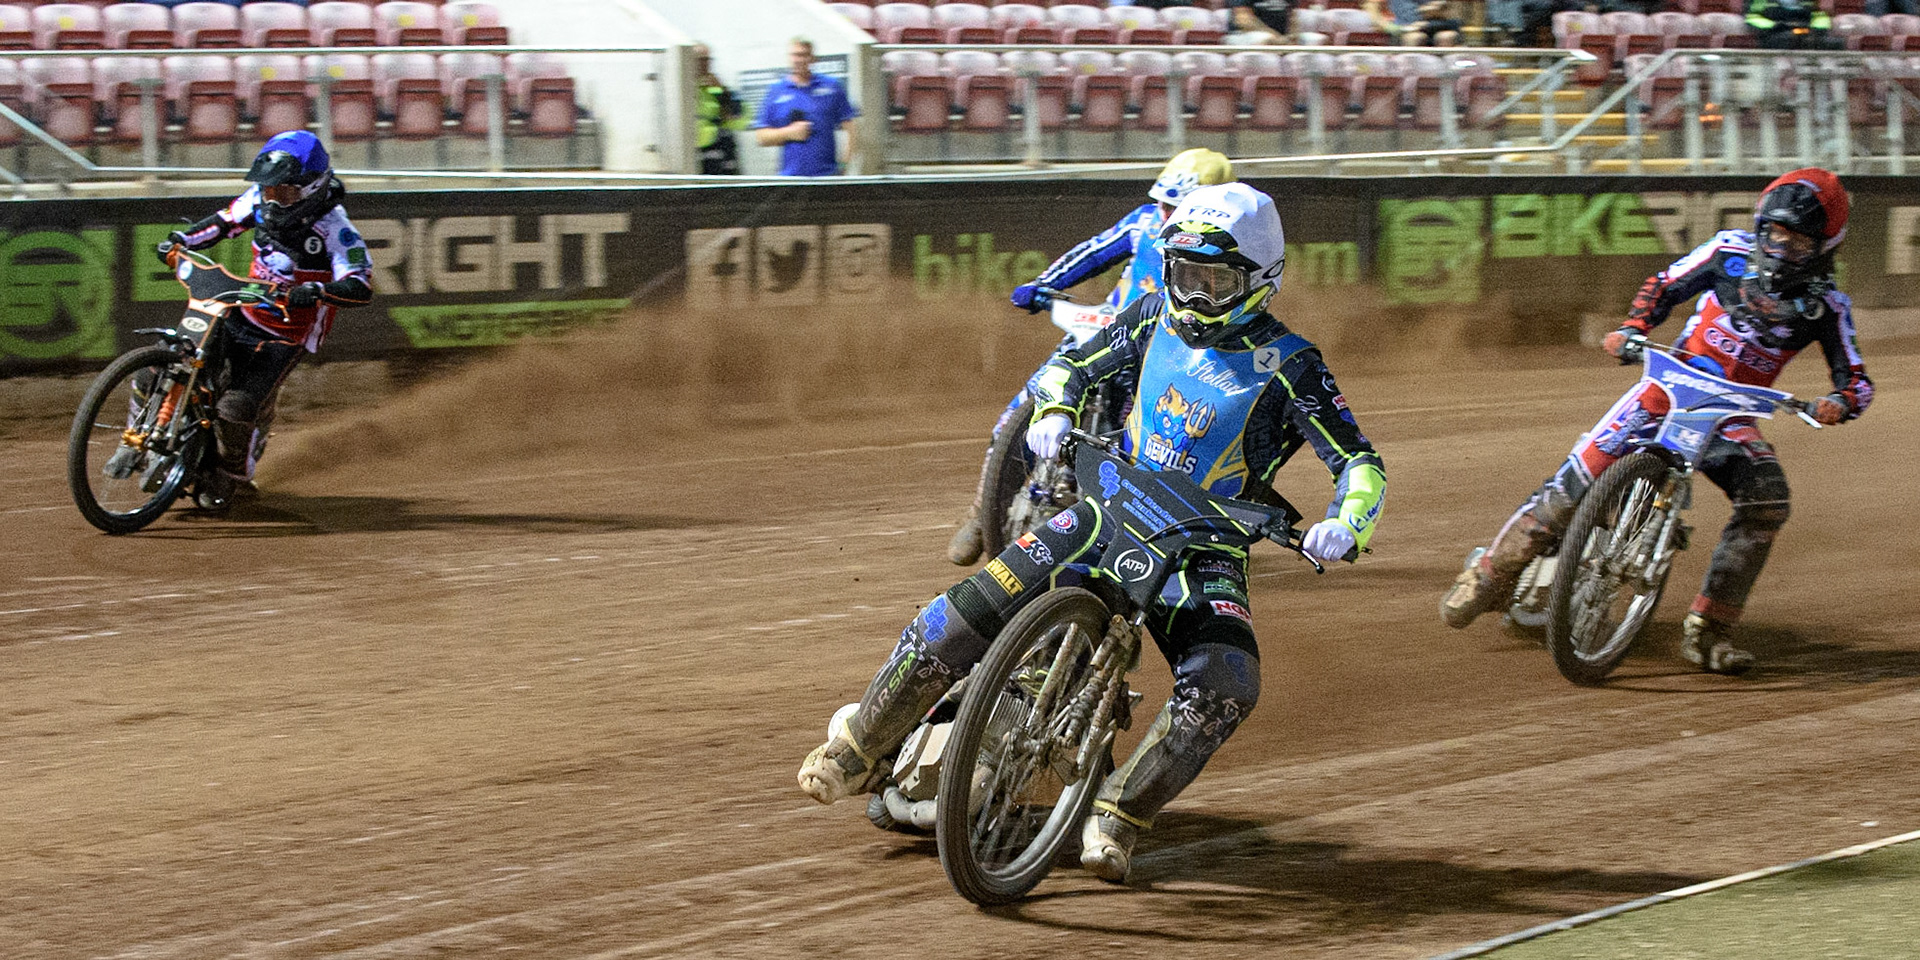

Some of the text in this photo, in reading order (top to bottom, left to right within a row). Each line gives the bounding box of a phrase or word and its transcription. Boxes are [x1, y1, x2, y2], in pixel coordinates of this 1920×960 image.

[1258, 351, 1275, 370] 1
[1144, 437, 1197, 474] DEVILS
[1120, 557, 1147, 574] ATPI
